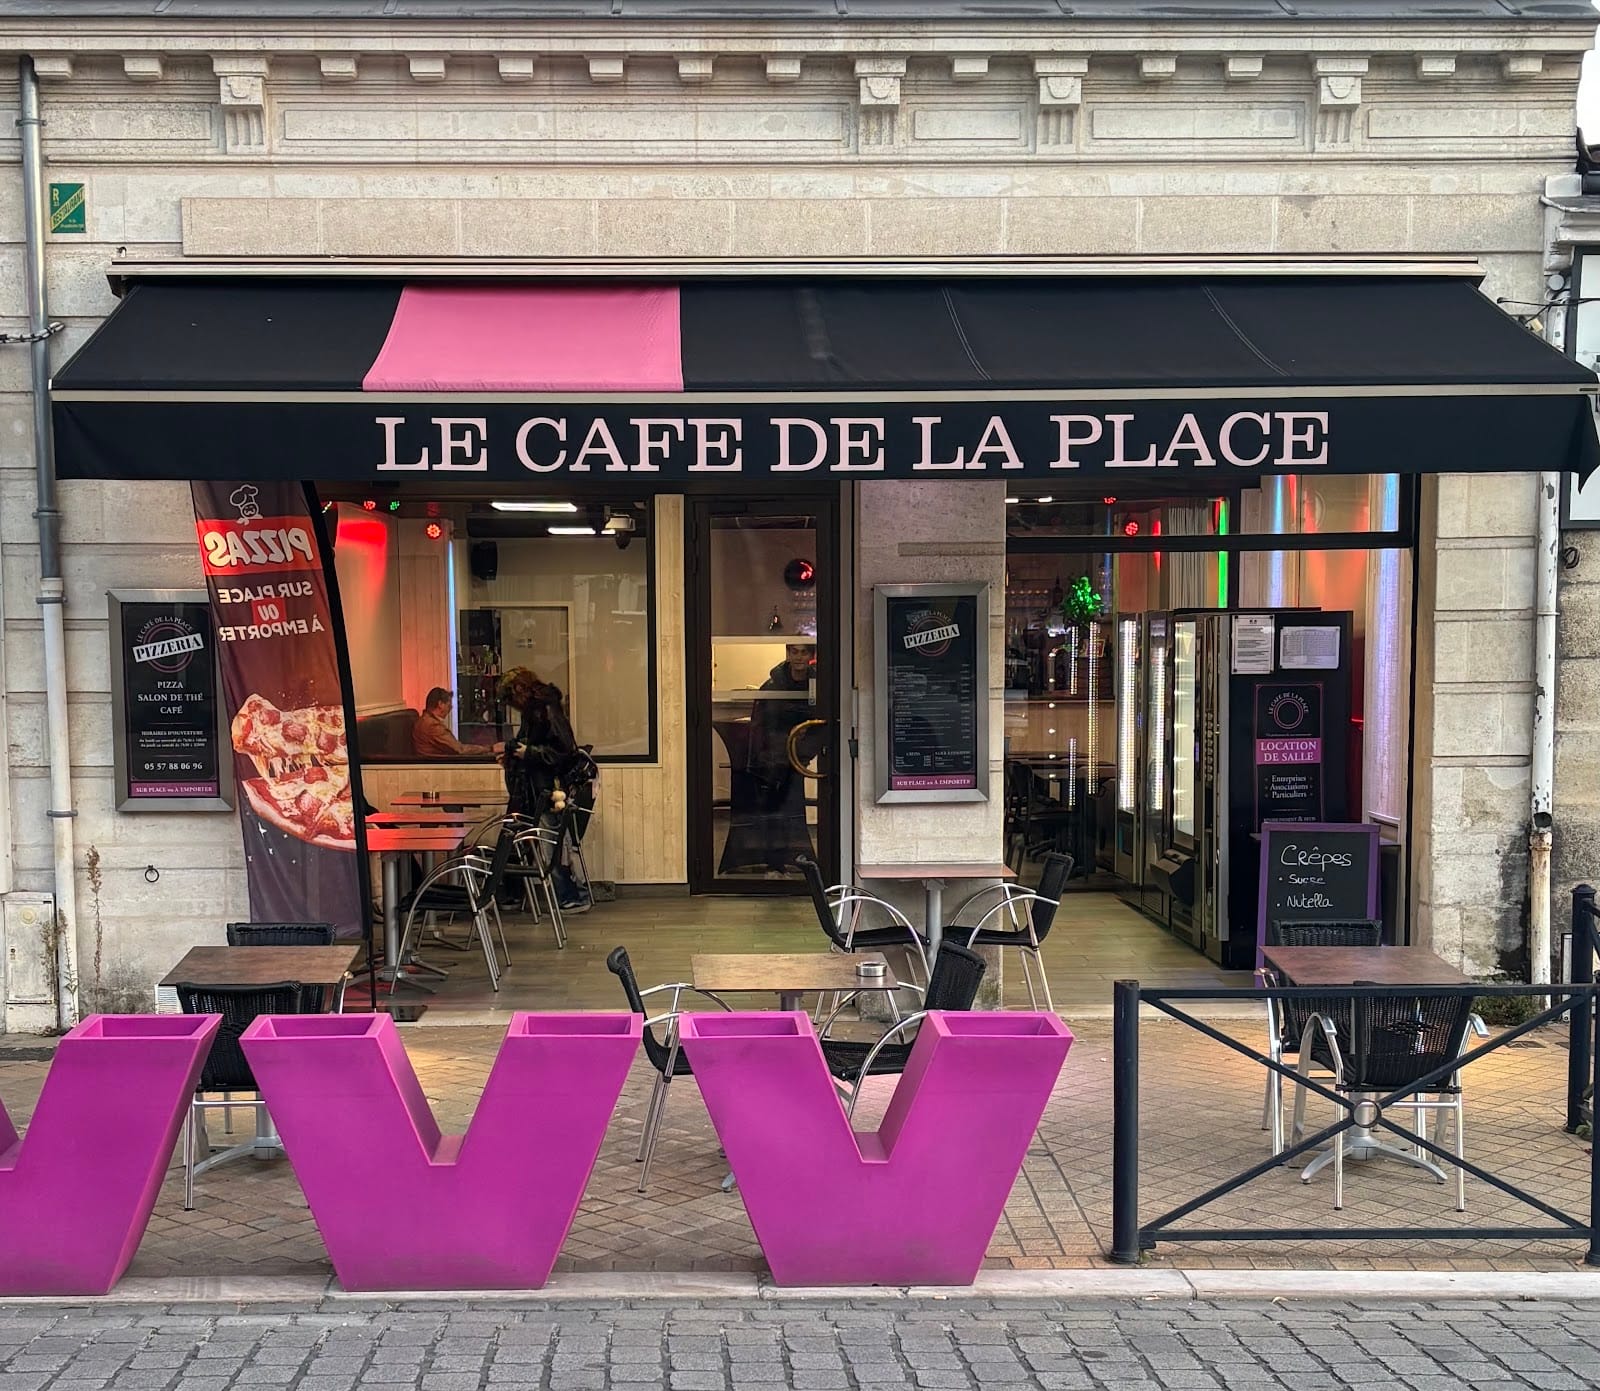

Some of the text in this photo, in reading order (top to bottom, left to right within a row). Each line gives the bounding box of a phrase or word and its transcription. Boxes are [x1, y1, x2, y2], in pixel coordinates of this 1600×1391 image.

[53, 188, 59, 202] R
[376, 411, 1329, 473] LE CAFE DE LA PLACE
[905, 626, 958, 647] PIZZERIA
[135, 636, 202, 660] PIZZERIA
[157, 681, 183, 689] PIZZA
[137, 692, 204, 702] SALON DE THÉ
[160, 705, 183, 714] CAFÉ
[1260, 741, 1317, 751] LOCATION
[1263, 752, 1314, 762] DE SALLE
[144, 762, 203, 770] 05 57 88 06 96
[1271, 774, 1306, 784] Entreprises
[1271, 790, 1307, 799] Particuliers
[1286, 892, 1334, 908] Nutella
